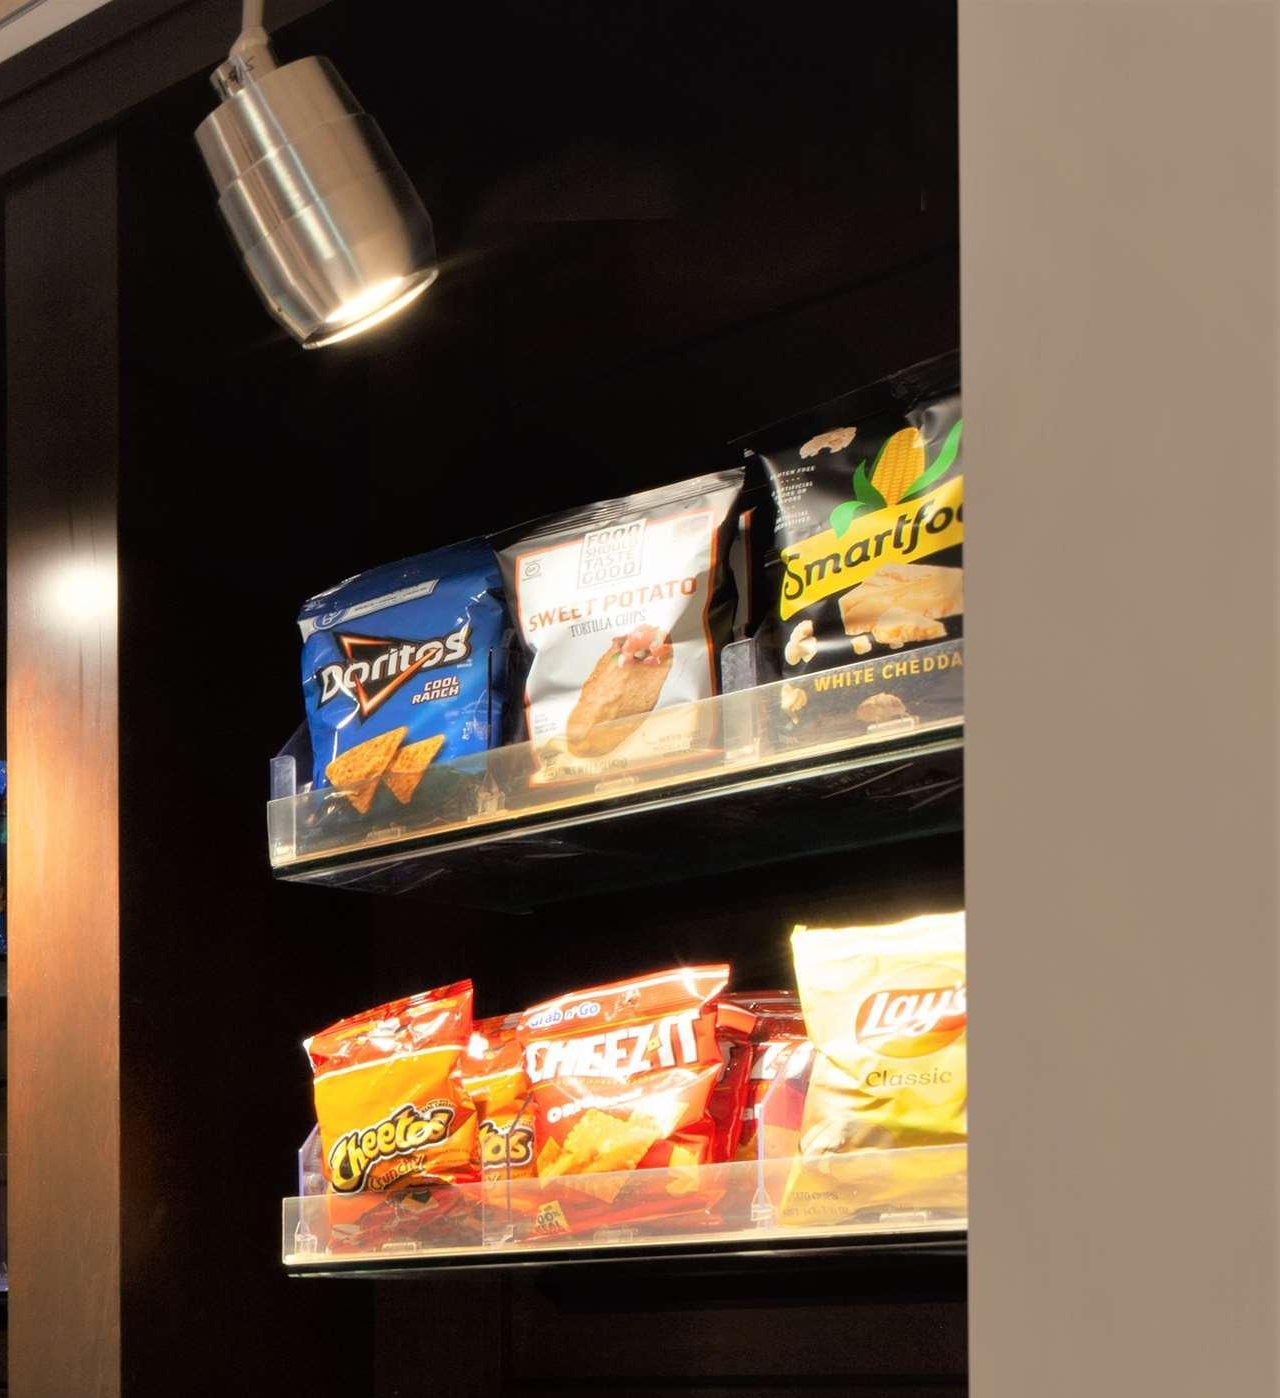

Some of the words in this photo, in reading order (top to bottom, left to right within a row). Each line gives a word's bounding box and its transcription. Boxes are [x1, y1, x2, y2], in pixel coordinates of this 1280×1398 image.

[784, 498, 963, 600] Smartfo
[529, 594, 596, 633] SWEET
[603, 575, 697, 613] POTATO
[569, 618, 613, 638] TORTILLA
[321, 629, 469, 703] Doritos
[424, 675, 459, 692] COOL
[814, 667, 875, 693] WHITE
[882, 652, 963, 680] CHEDDA
[412, 686, 460, 705] RANCH
[865, 1067, 952, 1088] Classic
[330, 1104, 455, 1193] Cheetos
[370, 1154, 427, 1191] Crunchy
